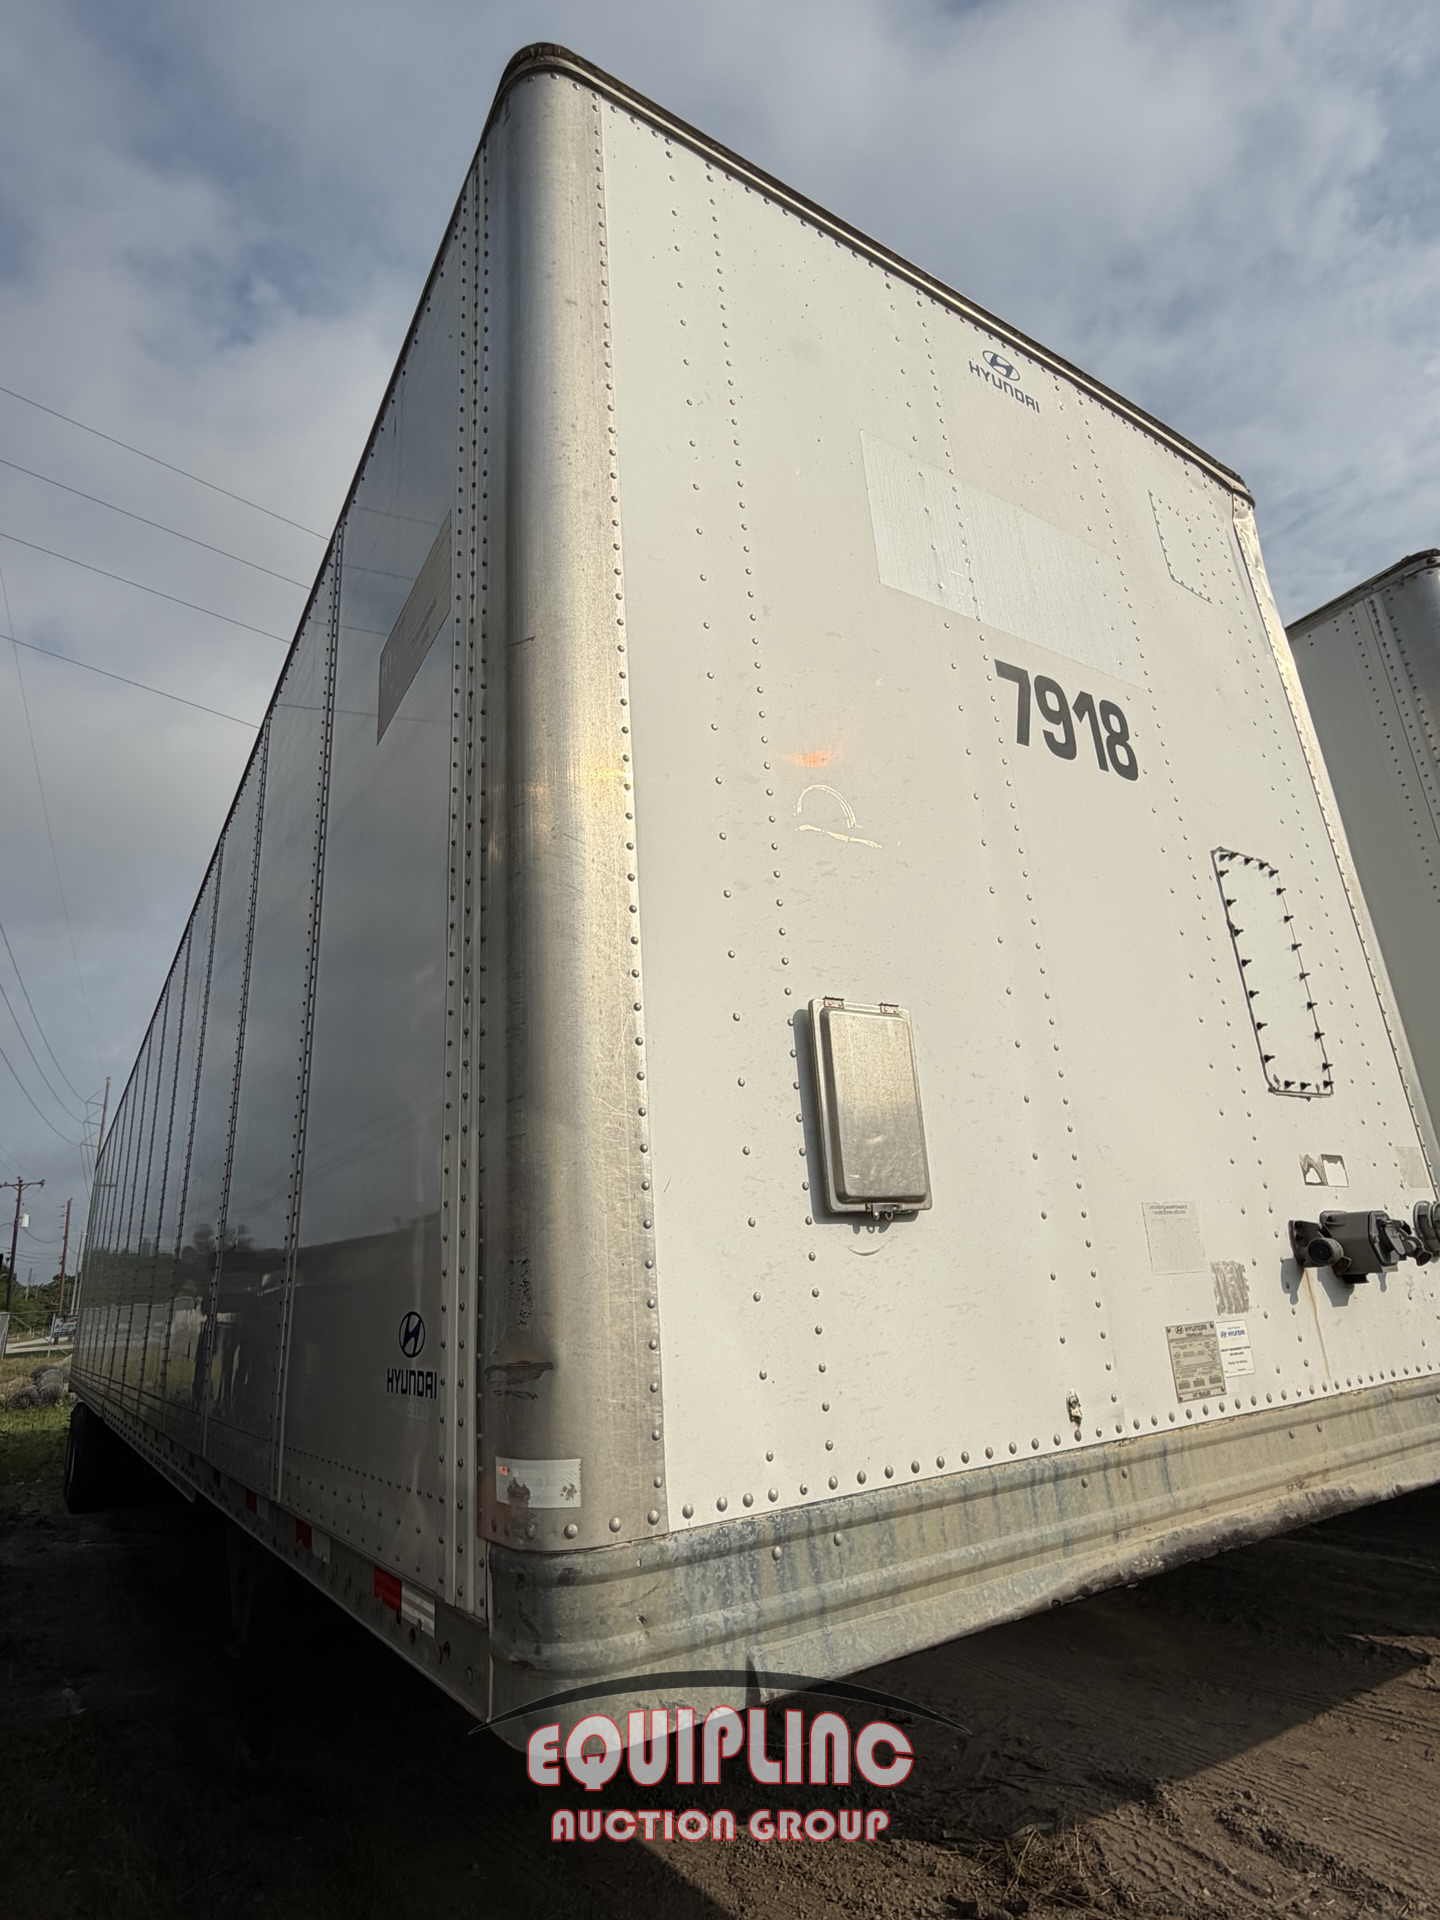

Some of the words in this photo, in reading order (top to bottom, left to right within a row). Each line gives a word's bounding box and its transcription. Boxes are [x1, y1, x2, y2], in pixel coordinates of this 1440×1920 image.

[968, 360, 1041, 413] HYUNDAI
[994, 659, 1139, 781] 7918
[386, 1368, 438, 1399] HYUNDAI
